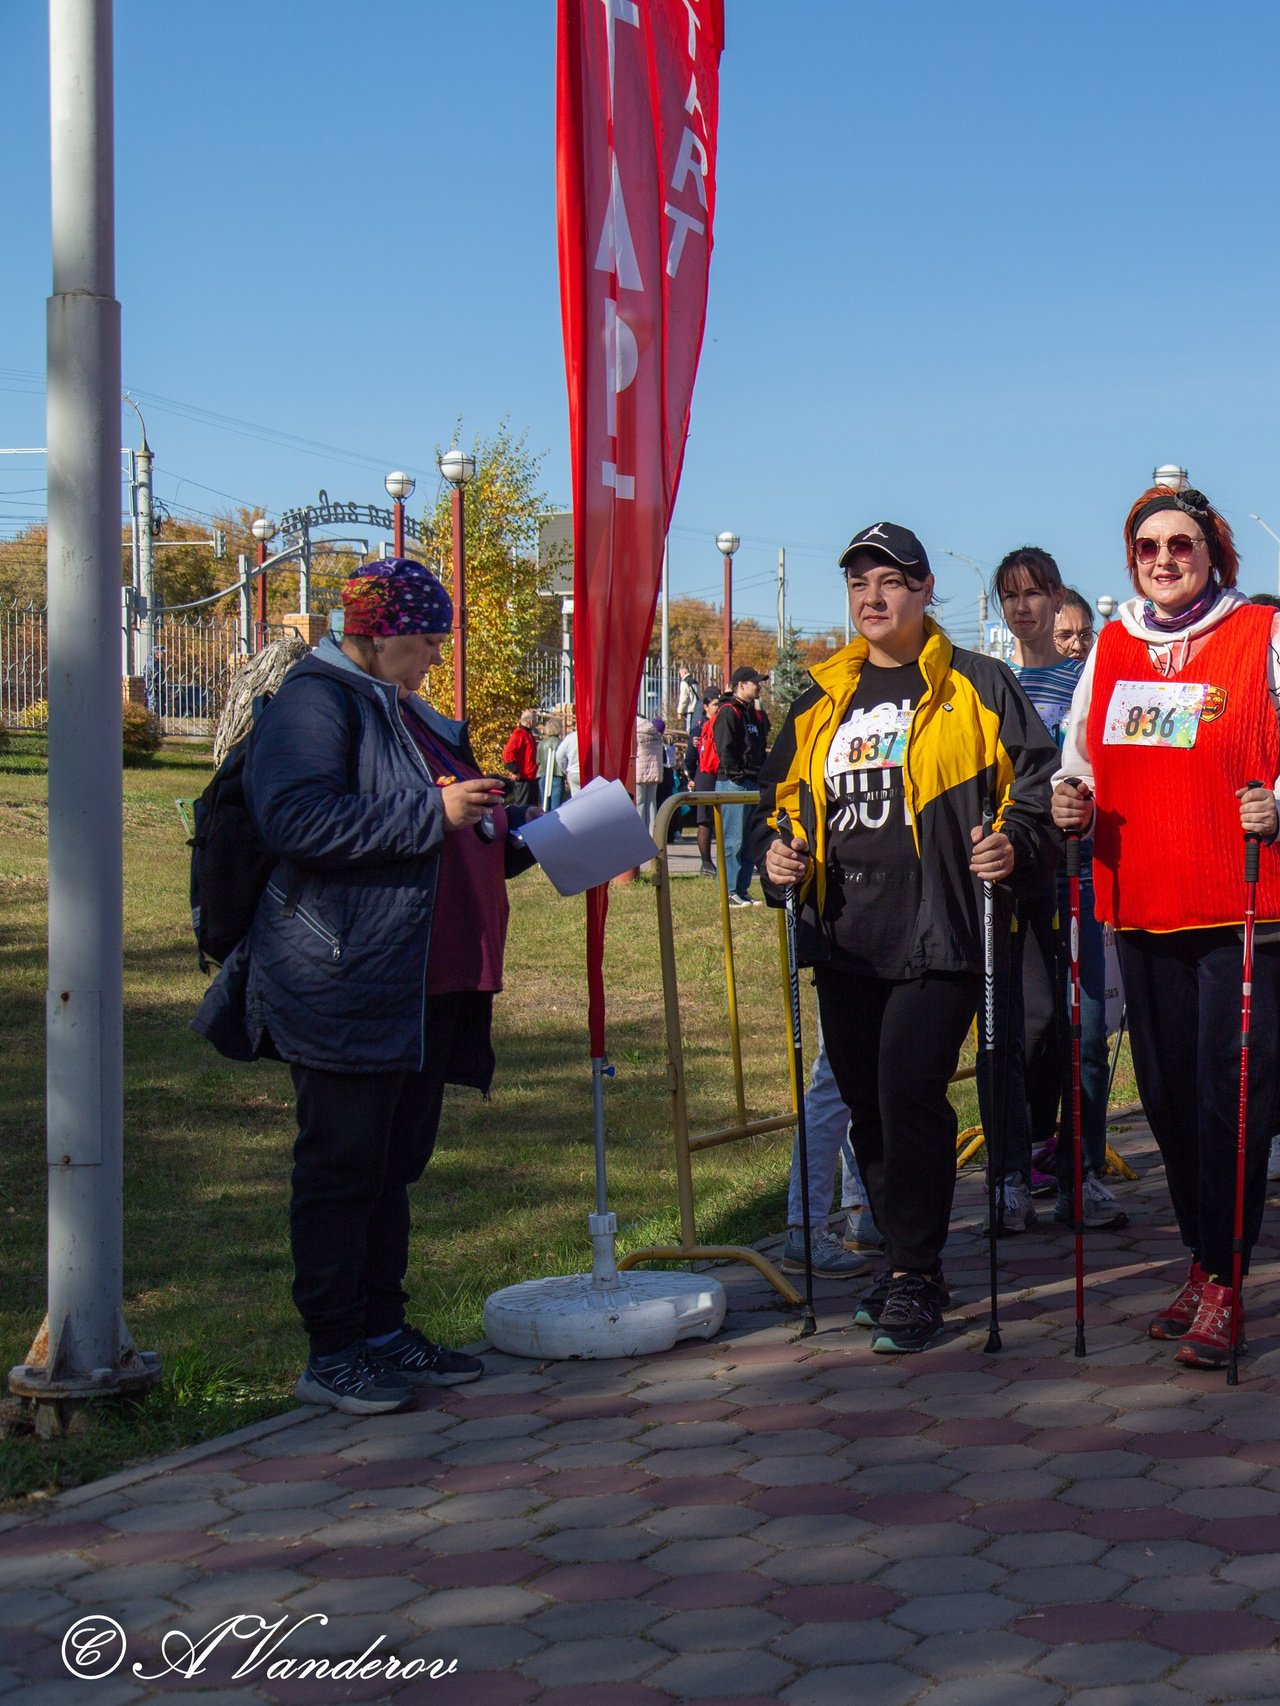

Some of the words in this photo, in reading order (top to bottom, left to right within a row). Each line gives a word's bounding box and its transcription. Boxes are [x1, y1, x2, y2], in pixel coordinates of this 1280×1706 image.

[664, 0, 708, 278] TART
[1125, 706, 1177, 738] 836
[848, 731, 899, 763] 837
